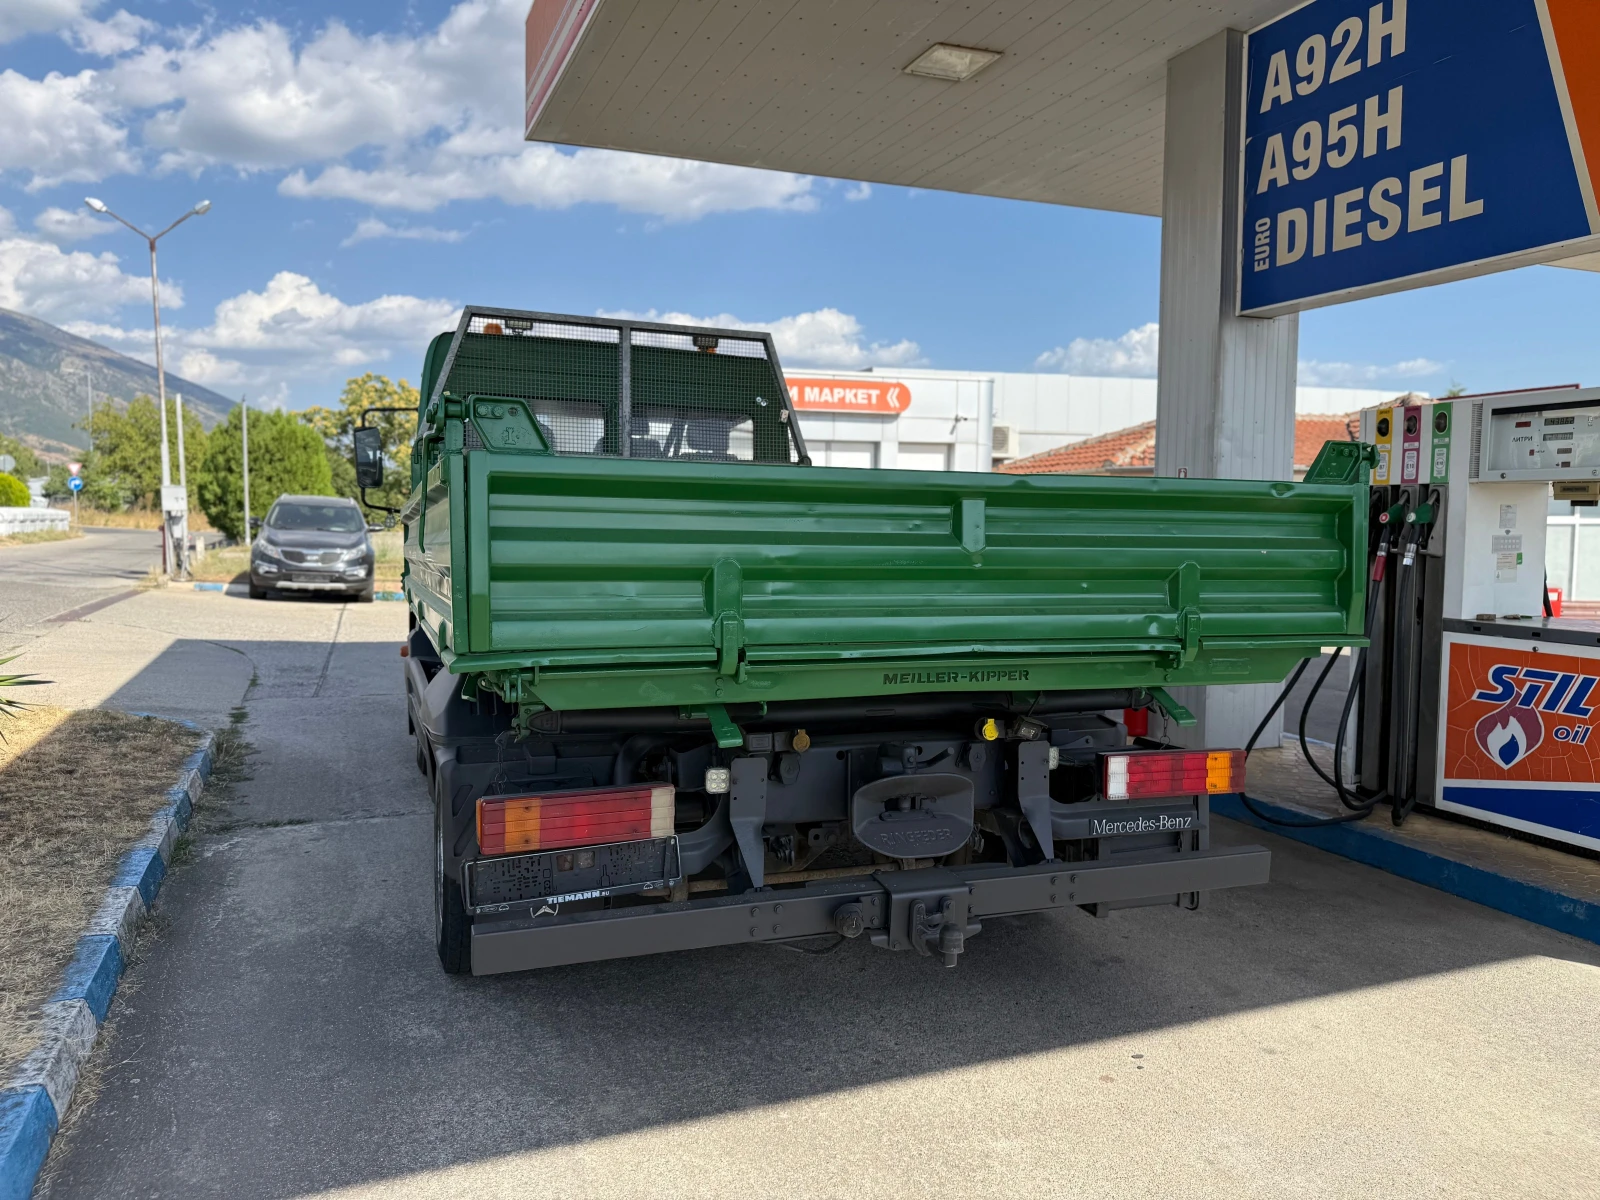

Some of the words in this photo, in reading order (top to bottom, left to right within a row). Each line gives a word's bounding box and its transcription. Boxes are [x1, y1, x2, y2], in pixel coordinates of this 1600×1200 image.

[1259, 0, 1407, 114] A92H
[1256, 85, 1403, 195] A95H
[1254, 217, 1271, 273] EURO
[1276, 154, 1484, 267] DIESEL
[804, 386, 880, 405] МАРКЕТ
[883, 669, 1030, 685] MEILLER-KIPPER
[1553, 724, 1592, 745] oil
[1093, 815, 1192, 835] Mercedes-Benz
[880, 828, 953, 845] RINGFEDER
